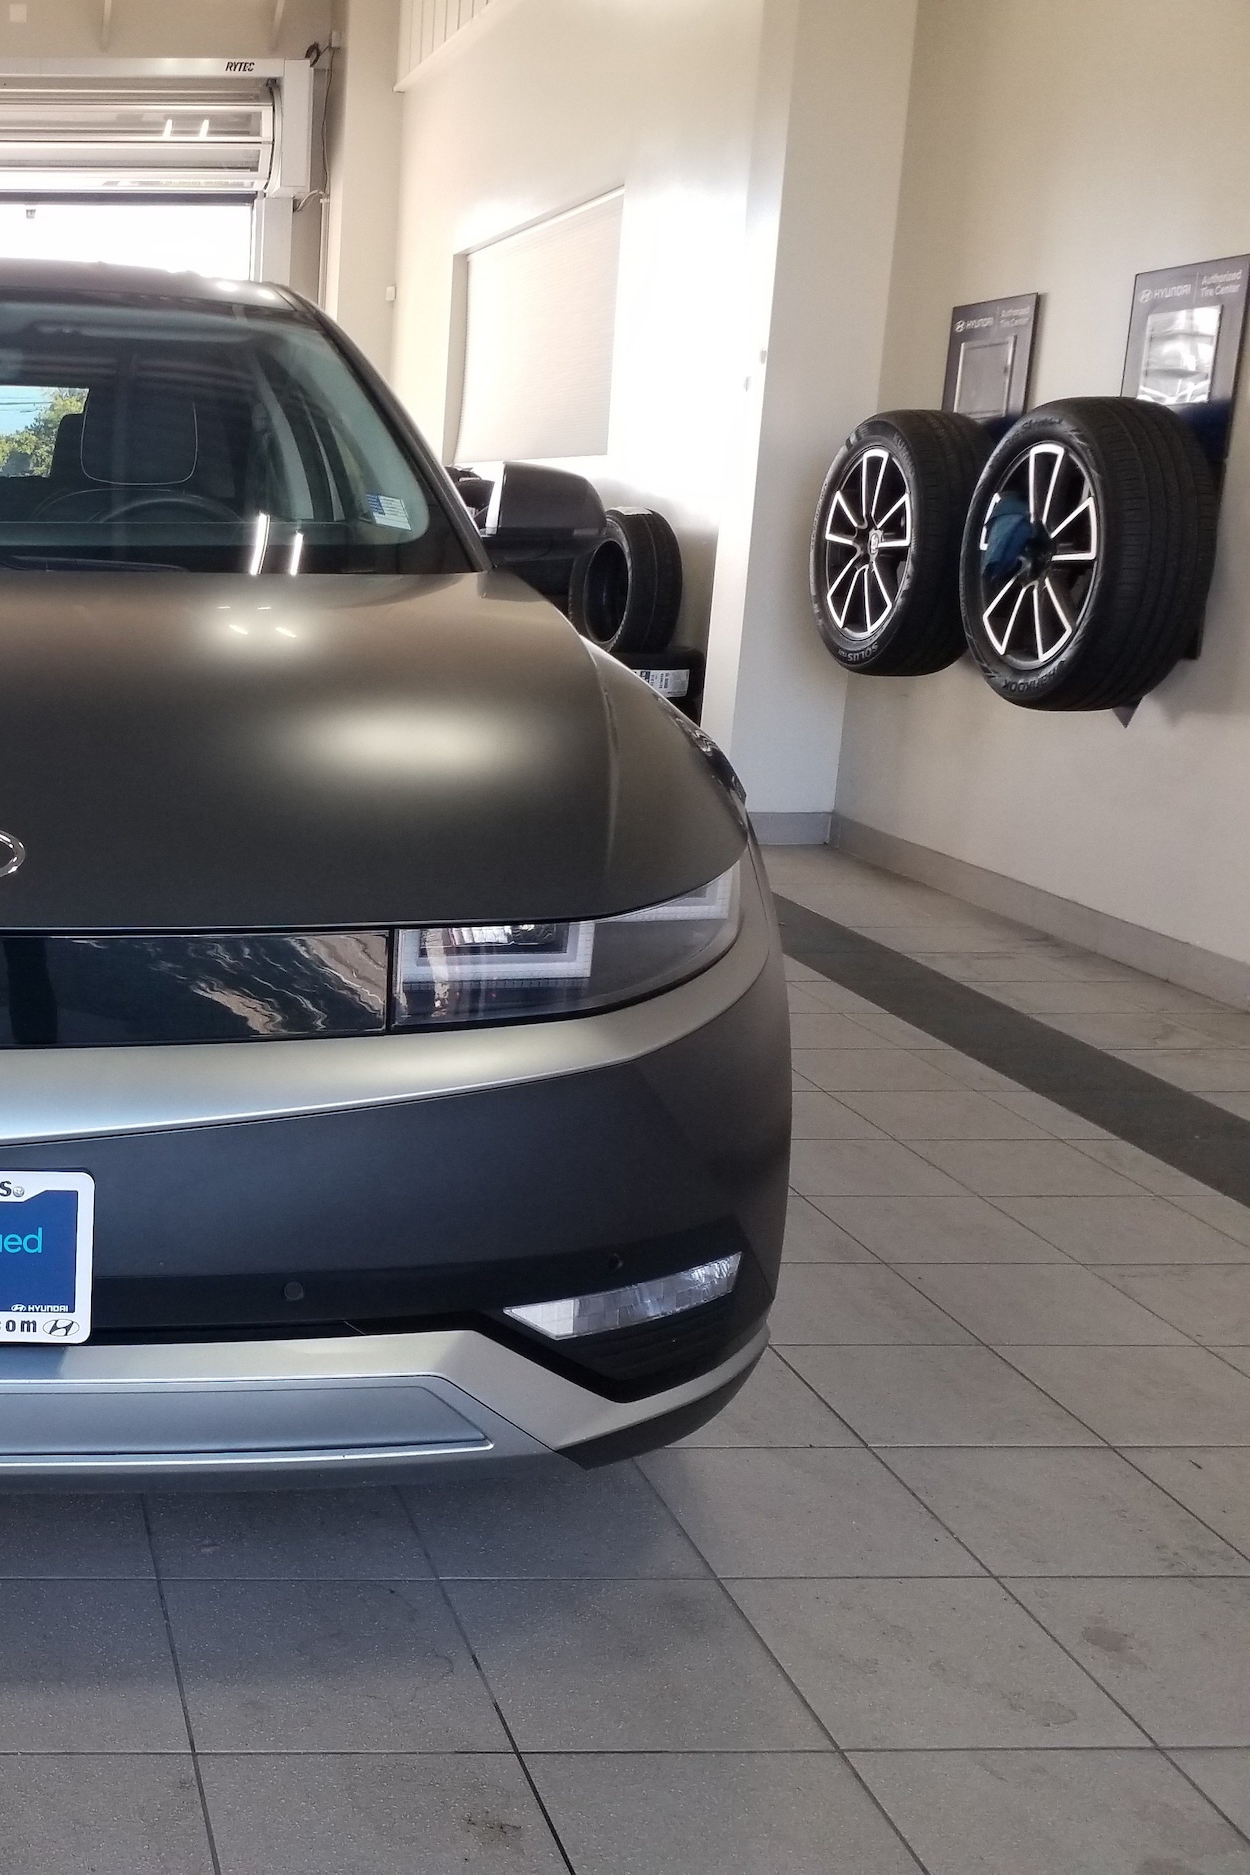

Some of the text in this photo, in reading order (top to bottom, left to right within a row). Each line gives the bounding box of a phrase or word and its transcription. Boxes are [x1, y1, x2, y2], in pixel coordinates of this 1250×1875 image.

[224, 61, 256, 72] RYTEC
[1153, 283, 1192, 299] HYUNDAI
[1214, 284, 1241, 296] Center
[847, 641, 878, 662] SOLUS
[27, 1304, 69, 1313] HYUNDAI
